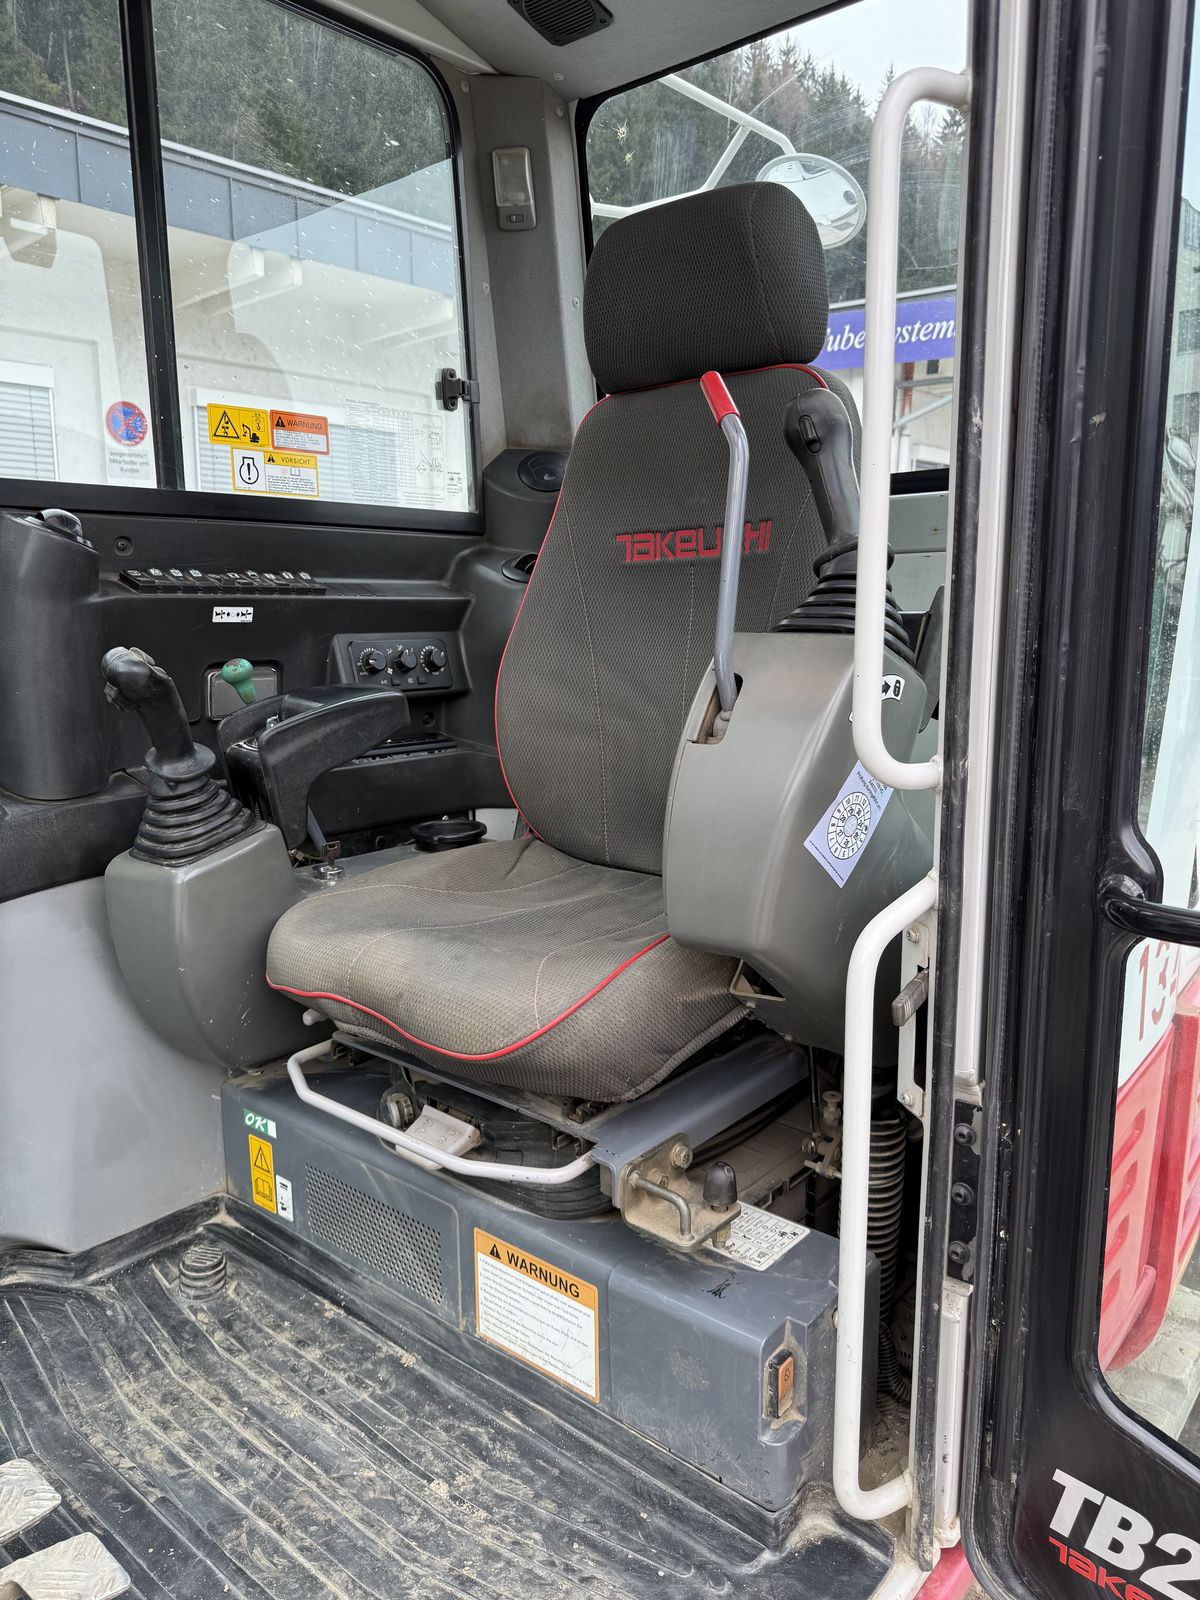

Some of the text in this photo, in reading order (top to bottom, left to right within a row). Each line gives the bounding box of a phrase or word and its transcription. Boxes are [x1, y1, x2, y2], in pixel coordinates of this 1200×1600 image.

[286, 419, 322, 430] WARNUNG
[280, 456, 311, 465] VORSICHT
[615, 520, 773, 563] TAKEUHI
[244, 1112, 267, 1132] OK
[506, 1250, 580, 1299] WARNUNG
[1049, 1468, 1200, 1600] TB2
